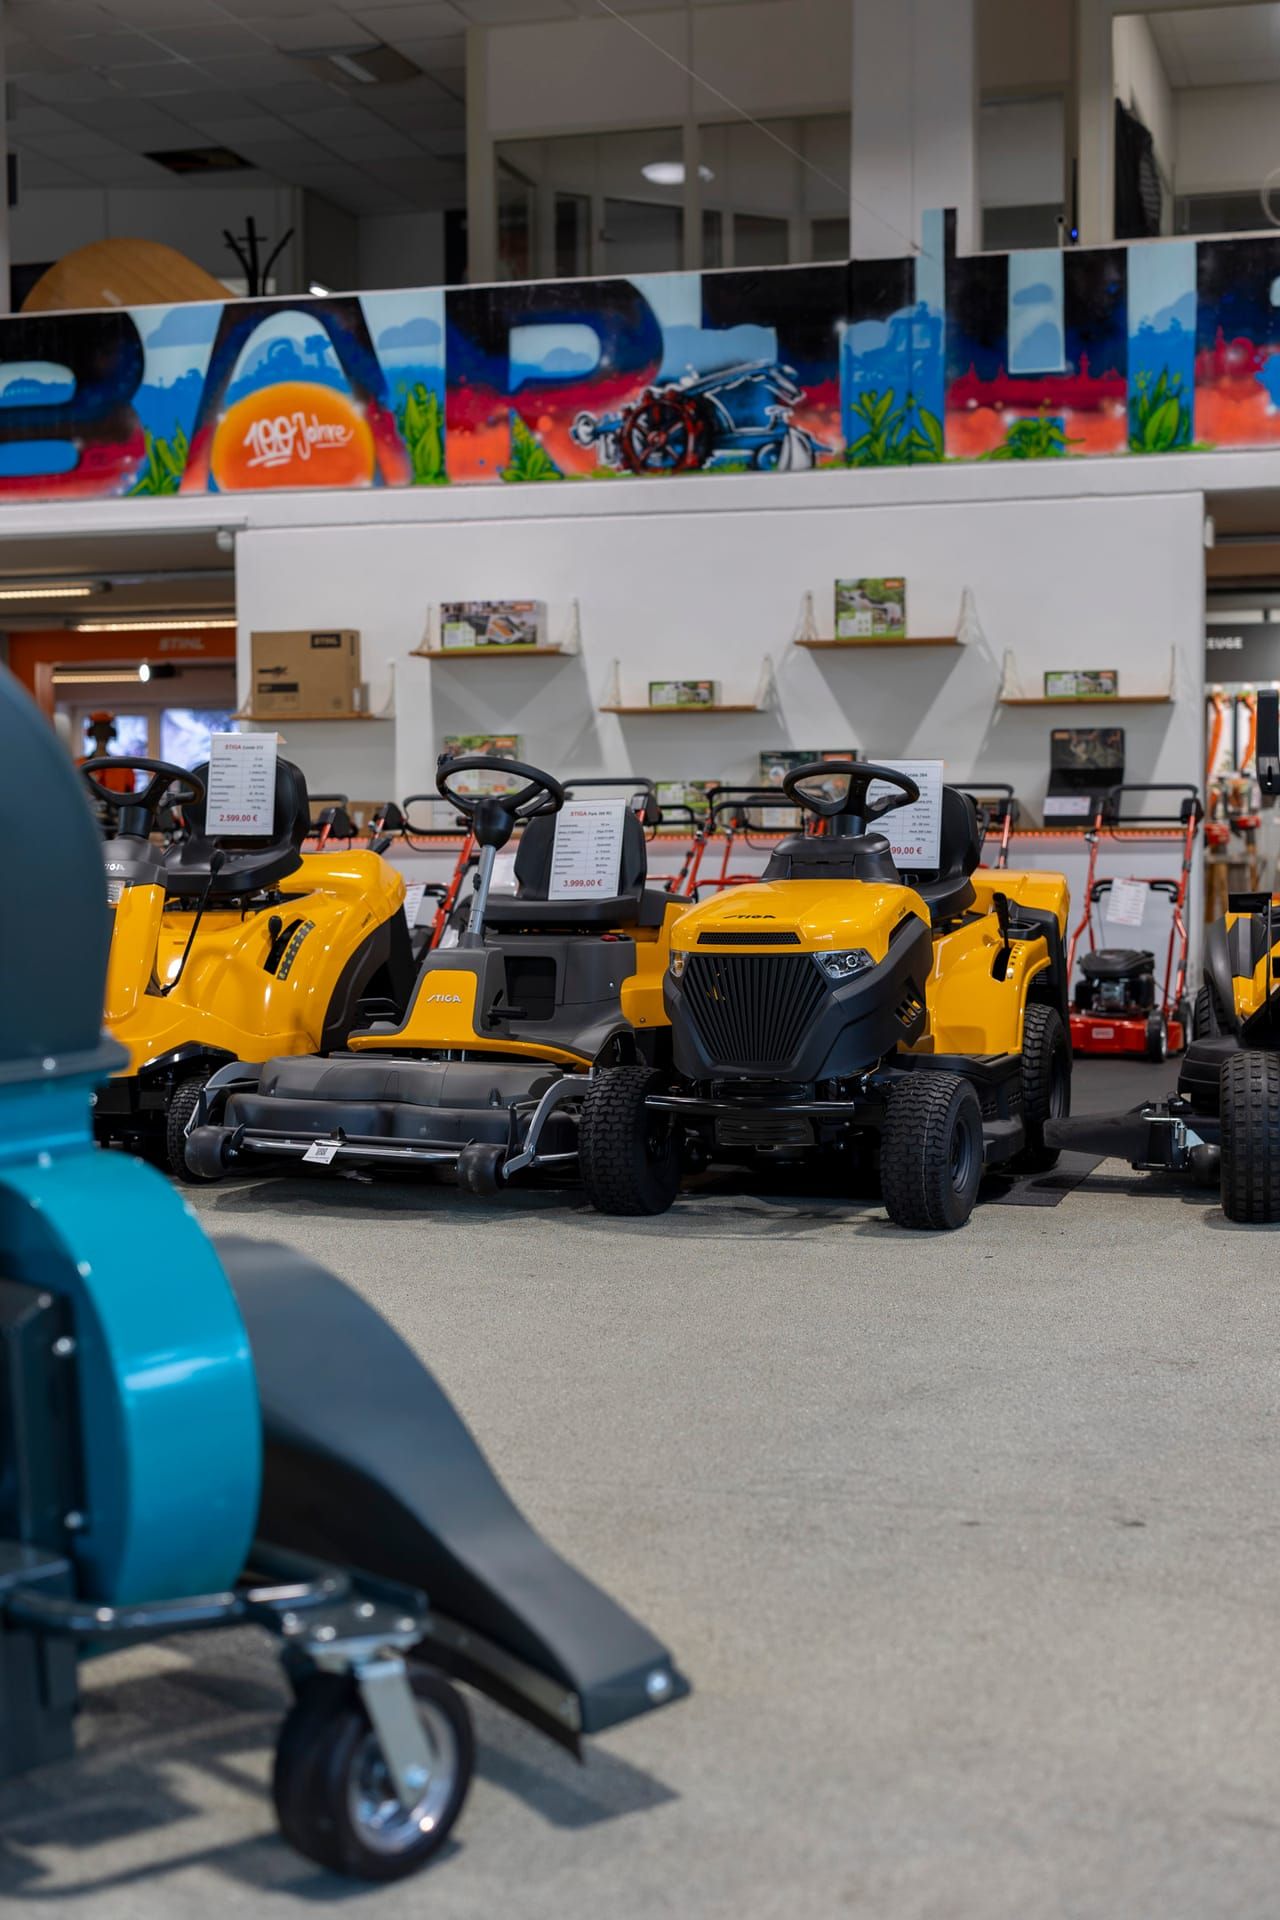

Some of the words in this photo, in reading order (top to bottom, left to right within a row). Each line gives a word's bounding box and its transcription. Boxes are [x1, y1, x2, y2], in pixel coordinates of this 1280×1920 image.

[243, 415, 297, 460] 100
[219, 813, 251, 823] 2.599,00
[252, 813, 258, 822] €
[889, 846, 914, 856] 99,00
[916, 846, 923, 855] €
[562, 879, 596, 888] 3.999,00
[597, 879, 603, 887] €
[427, 994, 462, 1003] STIGA
